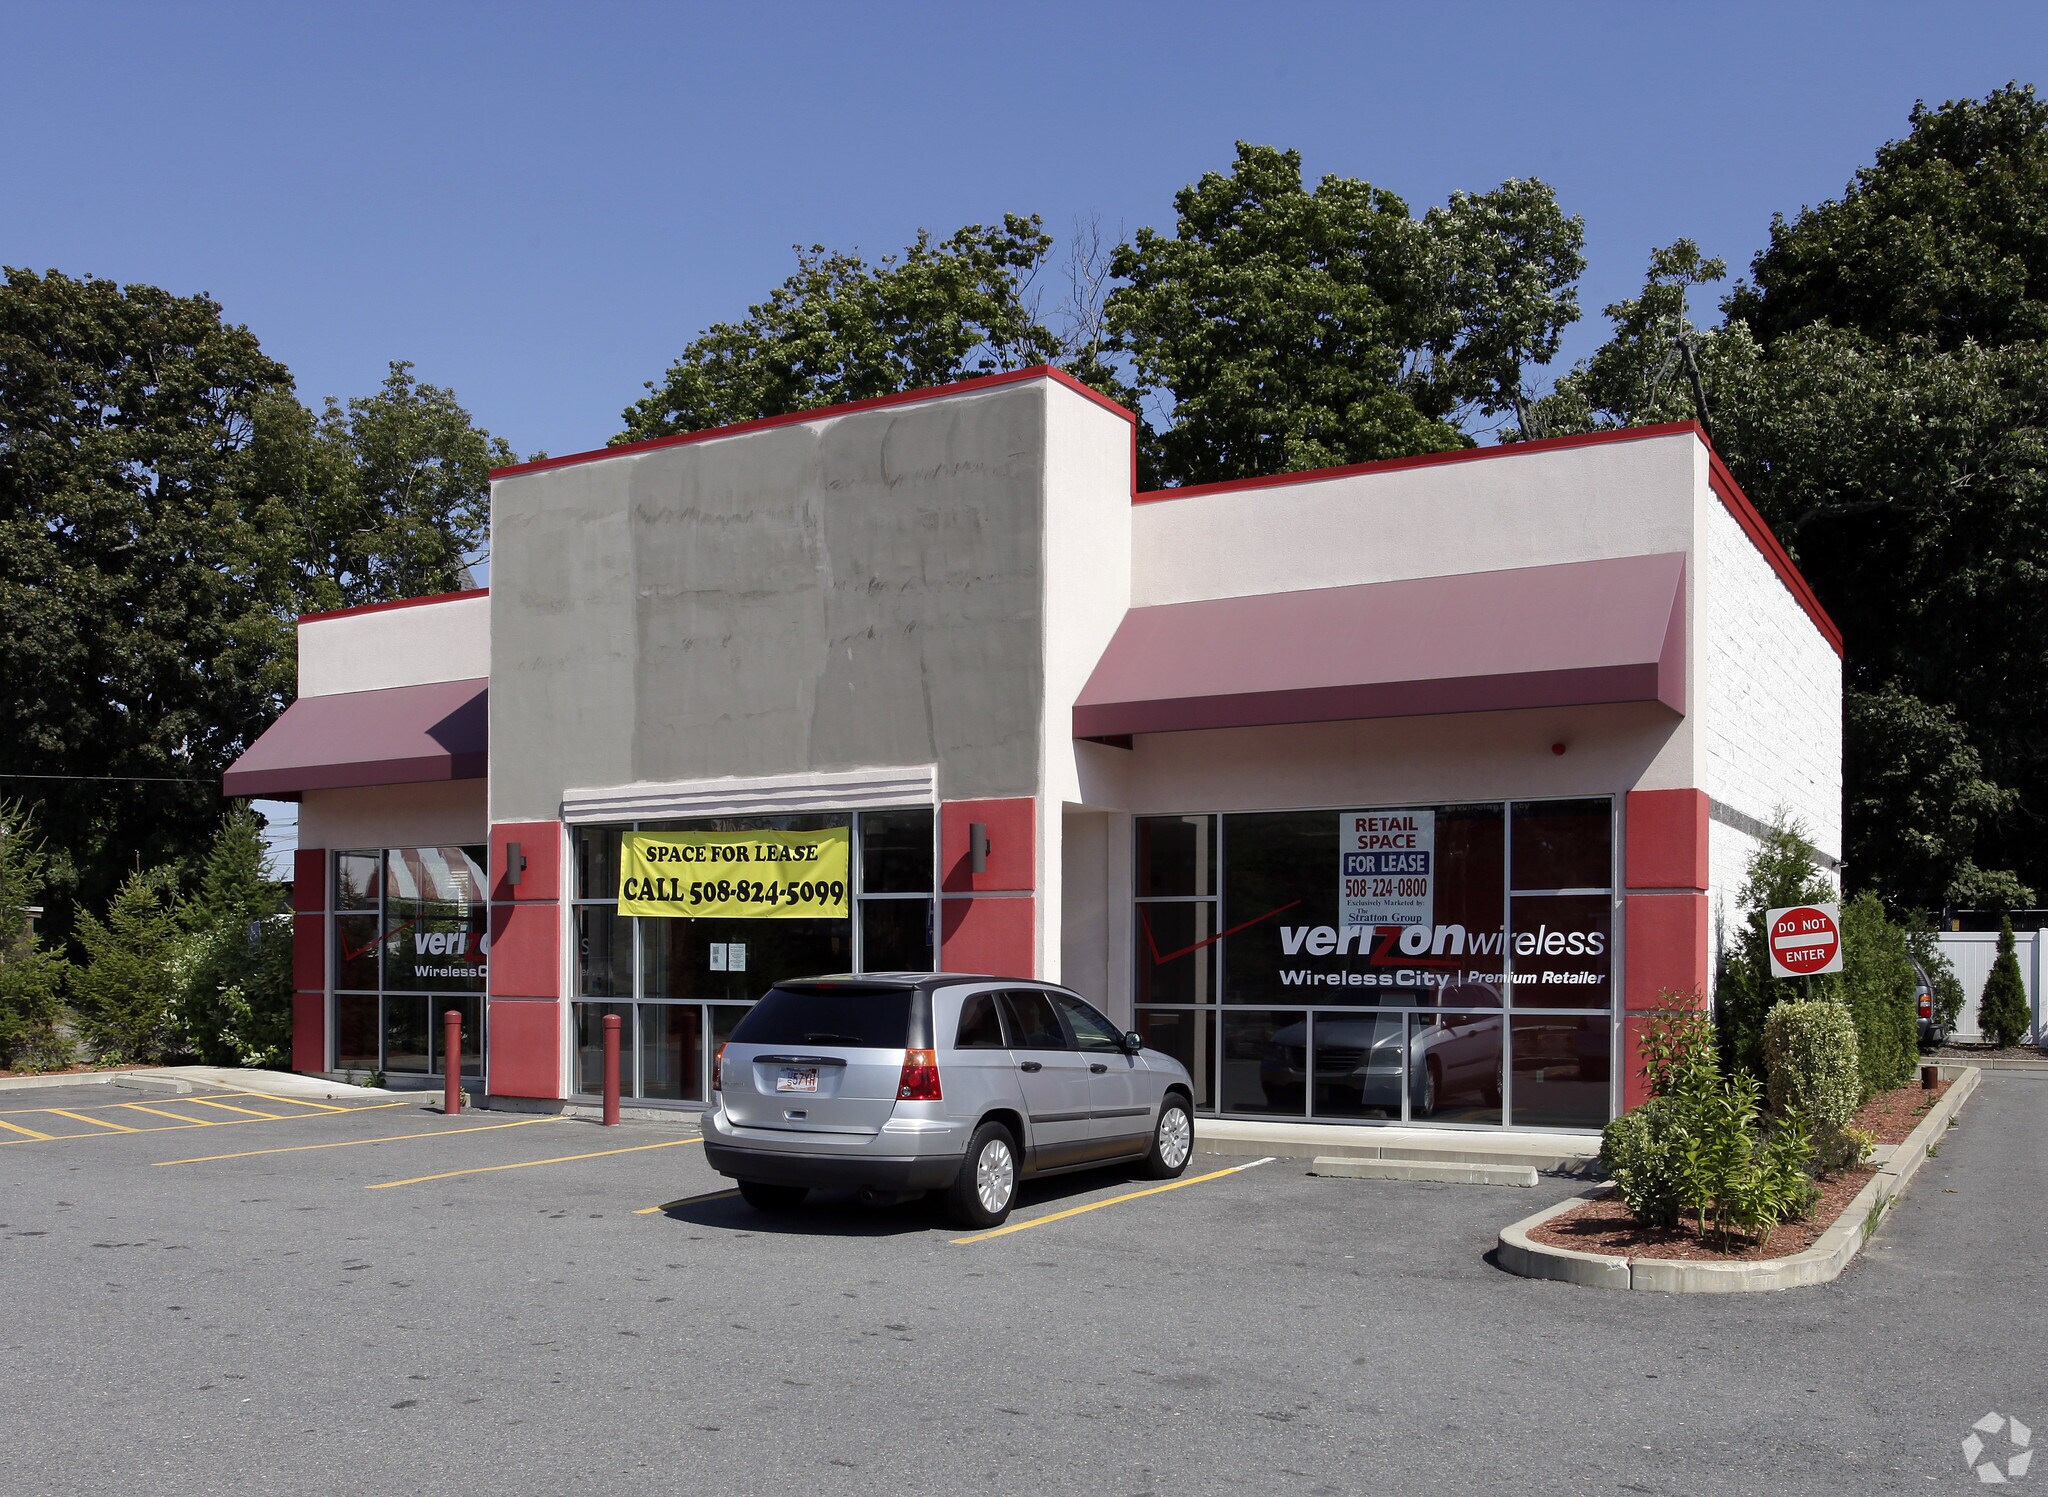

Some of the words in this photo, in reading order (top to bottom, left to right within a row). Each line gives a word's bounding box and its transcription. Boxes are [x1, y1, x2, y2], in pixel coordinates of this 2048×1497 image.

[1355, 817, 1418, 832] RETAIL
[1357, 834, 1416, 849] SPACE
[646, 846, 706, 862] SPACE
[711, 845, 750, 862] FOR
[754, 845, 818, 861] LEASE
[1348, 855, 1376, 873] FOR
[1381, 854, 1425, 872] LEASE
[623, 877, 684, 902] CALL
[690, 880, 844, 905] 508-824-5099
[1345, 878, 1427, 897] 508-224-0800
[1348, 913, 1388, 923] Stratton
[1391, 912, 1422, 924] Group
[1778, 921, 1795, 933] DO
[1802, 918, 1826, 930] NOT
[1279, 925, 1466, 966] verizon
[1786, 949, 1825, 962] ENTER
[1279, 969, 1450, 987] WirelessCity
[1468, 970, 1537, 984] Premium
[1542, 971, 1605, 984] Retailer
